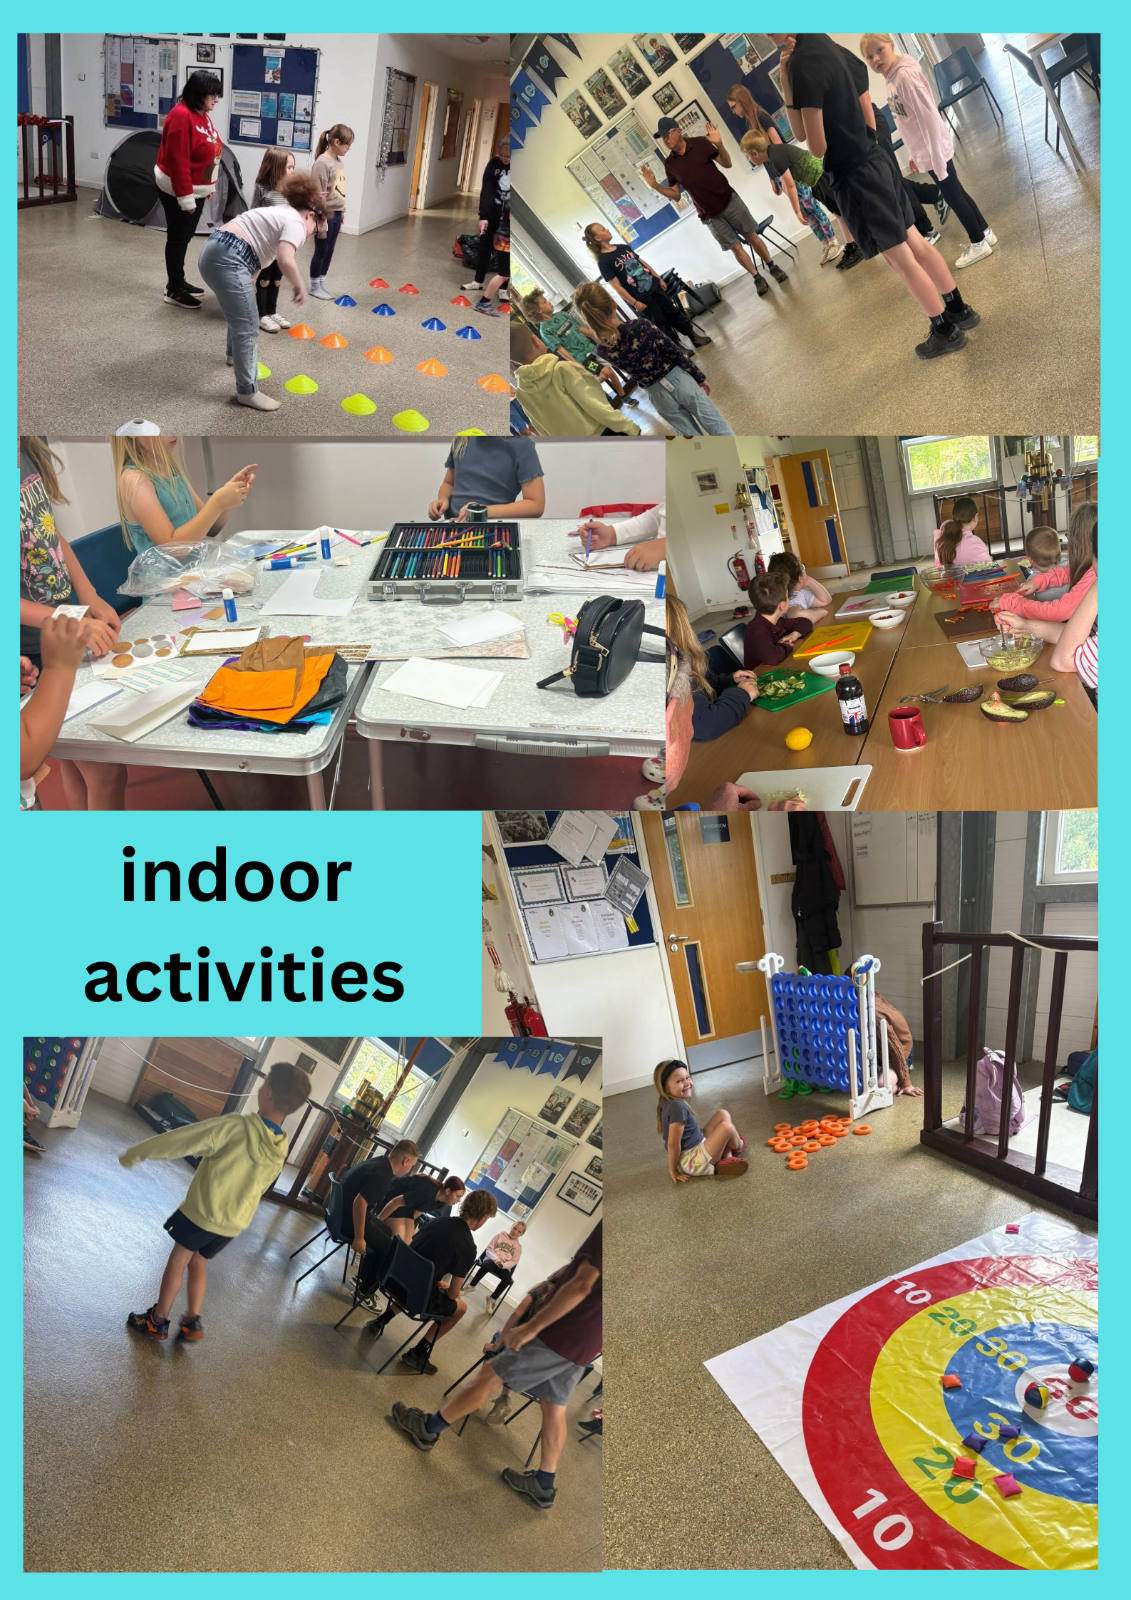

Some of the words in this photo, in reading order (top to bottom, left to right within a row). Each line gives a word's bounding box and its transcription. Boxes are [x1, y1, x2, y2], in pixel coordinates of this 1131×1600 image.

[893, 1280, 932, 1306] 10
[926, 1306, 978, 1337] 20
[975, 1336, 1028, 1371] 30
[972, 1412, 1041, 1464] 30
[912, 1446, 982, 1505] 20
[852, 1487, 915, 1551] 10
